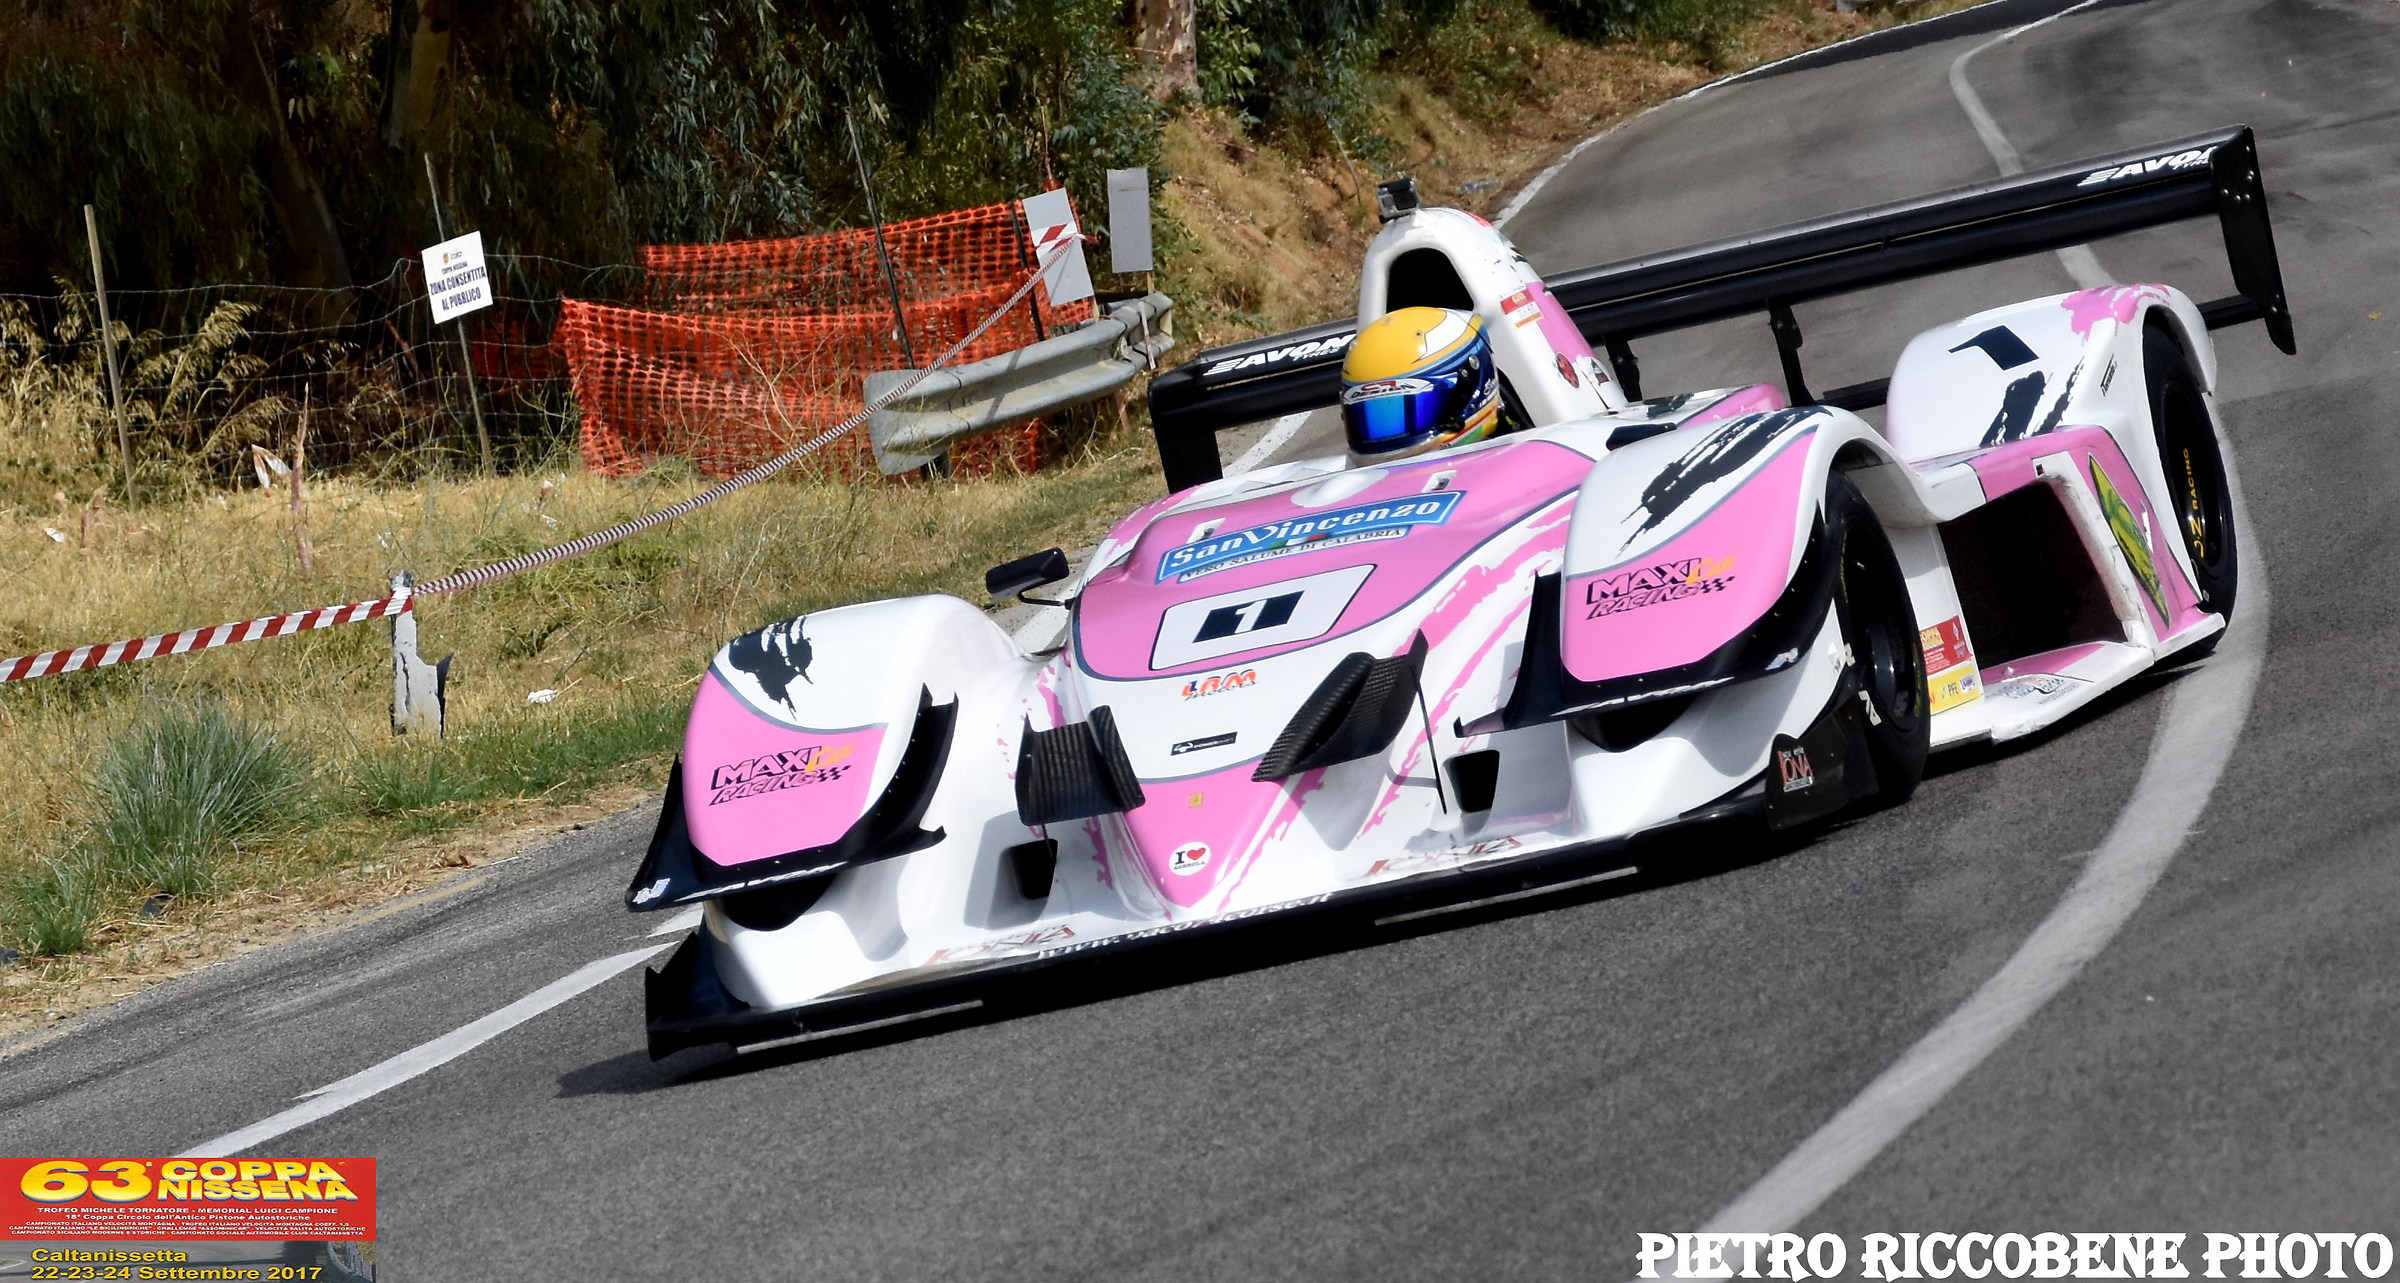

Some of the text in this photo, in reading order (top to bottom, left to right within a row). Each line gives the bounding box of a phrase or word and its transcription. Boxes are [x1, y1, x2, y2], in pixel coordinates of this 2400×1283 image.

[429, 266, 487, 296] ZONA CONSENTITA
[441, 286, 482, 311] AL PUBBLICO
[1234, 333, 1358, 370] AVON
[1186, 529, 1401, 578] VERO SALUME DI CALABRIA
[1586, 557, 1702, 605] MAXI
[1586, 582, 1703, 620] RACING
[710, 745, 822, 791] MAXI
[708, 771, 819, 807] RACING
[1174, 850, 1186, 866] I
